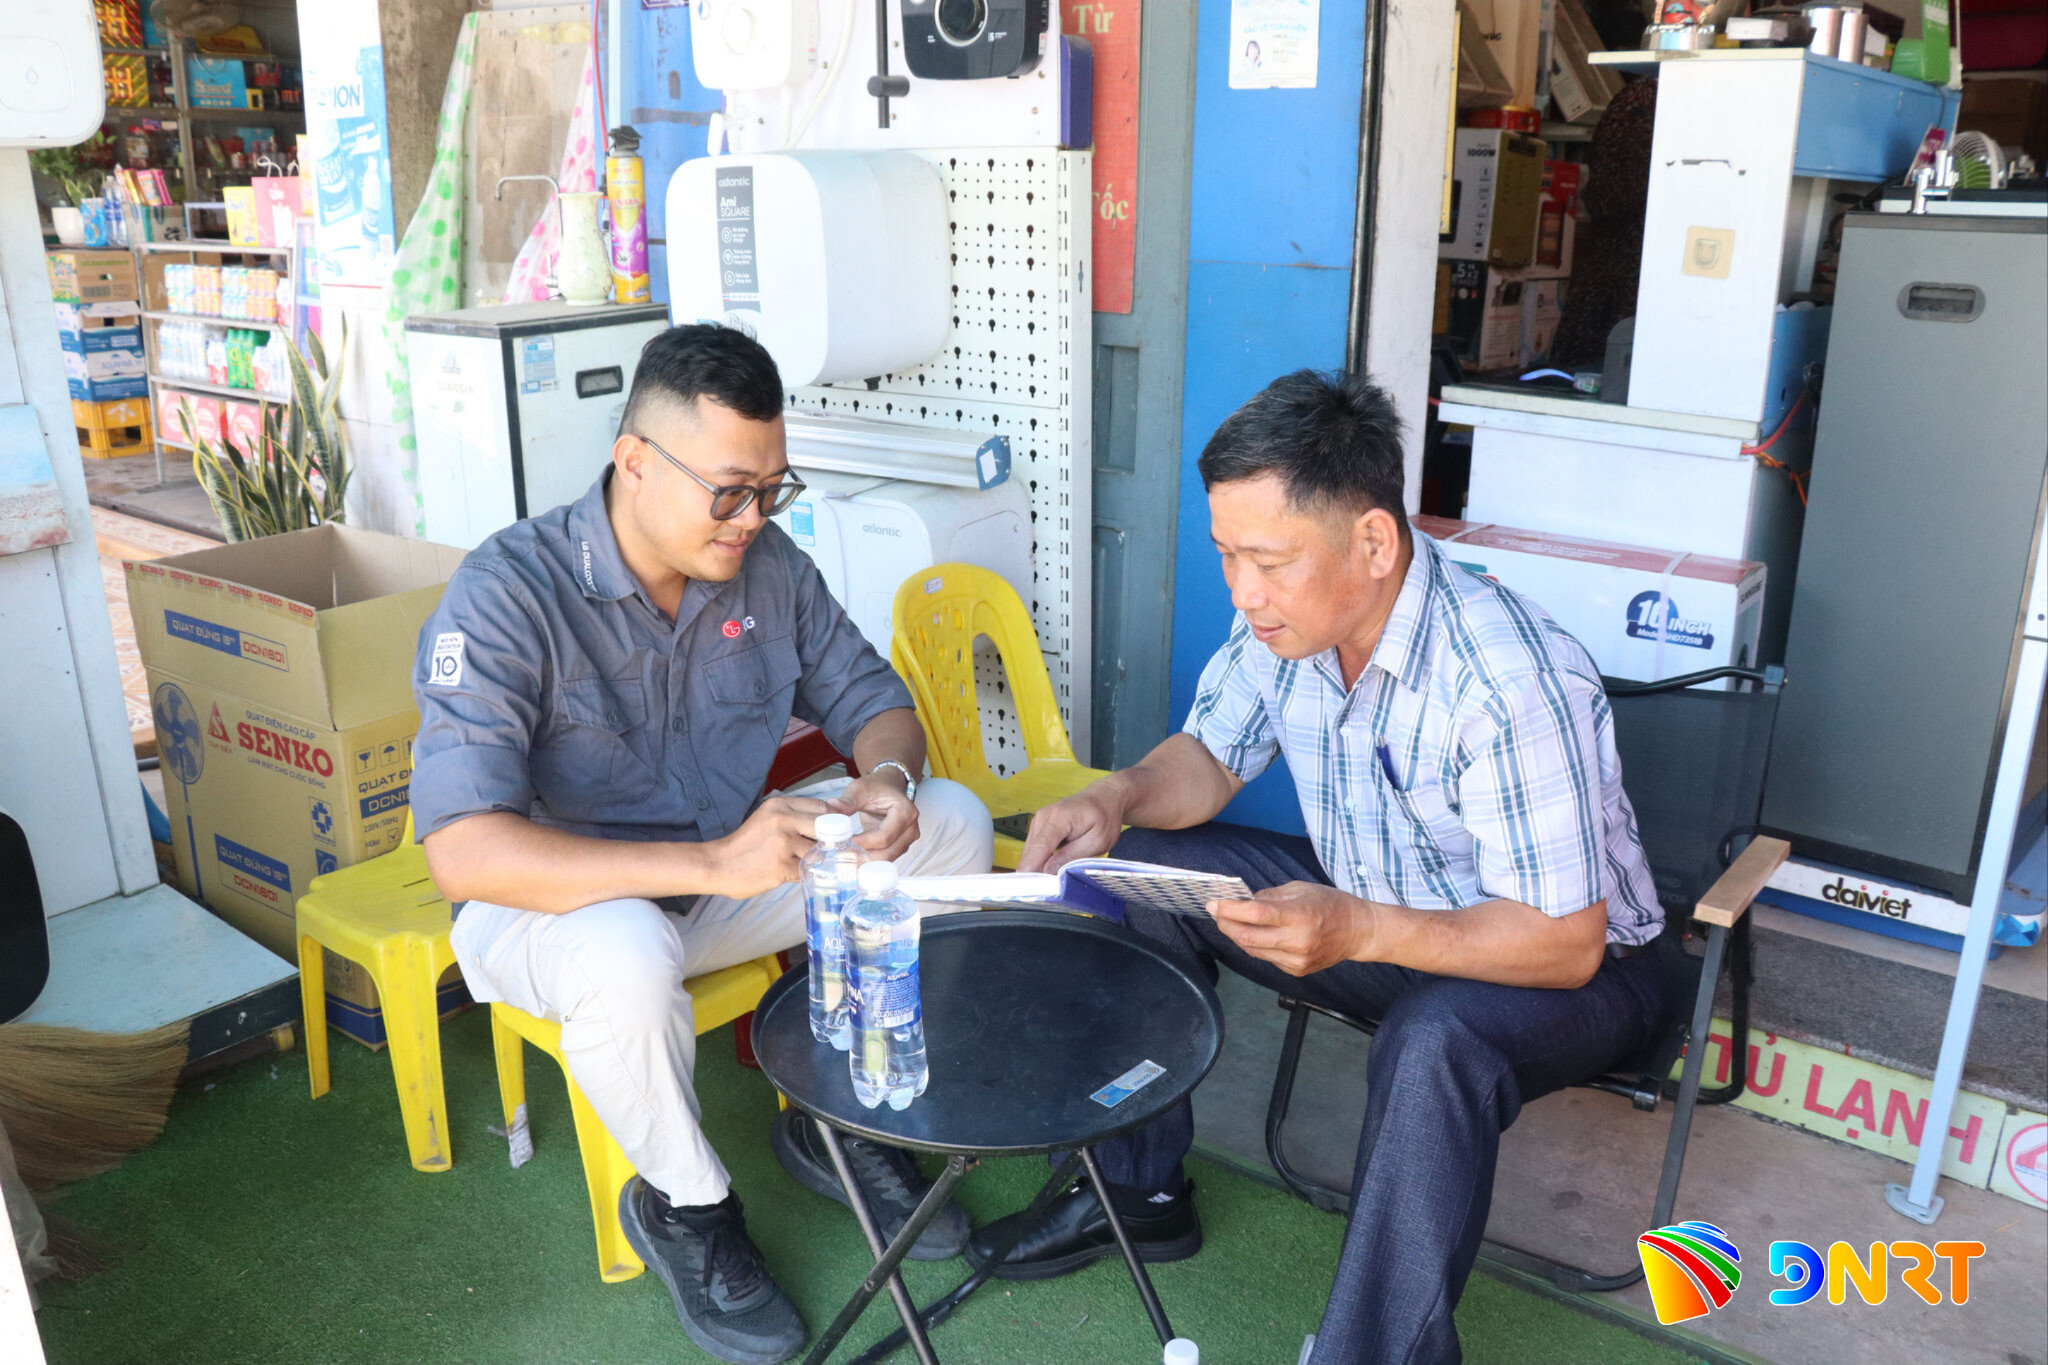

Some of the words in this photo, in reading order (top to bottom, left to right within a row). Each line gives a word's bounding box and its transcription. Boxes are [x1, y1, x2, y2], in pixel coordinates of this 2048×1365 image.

[1072, 4, 1115, 34] Từ
[718, 176, 751, 188] atlantic
[720, 195, 736, 207] Ami
[720, 206, 750, 217] SQUARE
[862, 524, 902, 538] atlantic
[288, 602, 314, 618] SENKO
[1636, 628, 1660, 638] Mode
[1668, 617, 1712, 636] INCH
[243, 641, 285, 664] DCN1801
[435, 656, 457, 677] 10
[283, 723, 299, 736] CAO
[237, 721, 334, 778] SENKO
[368, 788, 410, 813] DCN1
[1822, 877, 1912, 919] daiviet
[1708, 1031, 1786, 1098] TỦ
[1801, 1063, 1985, 1165] LẠNH
